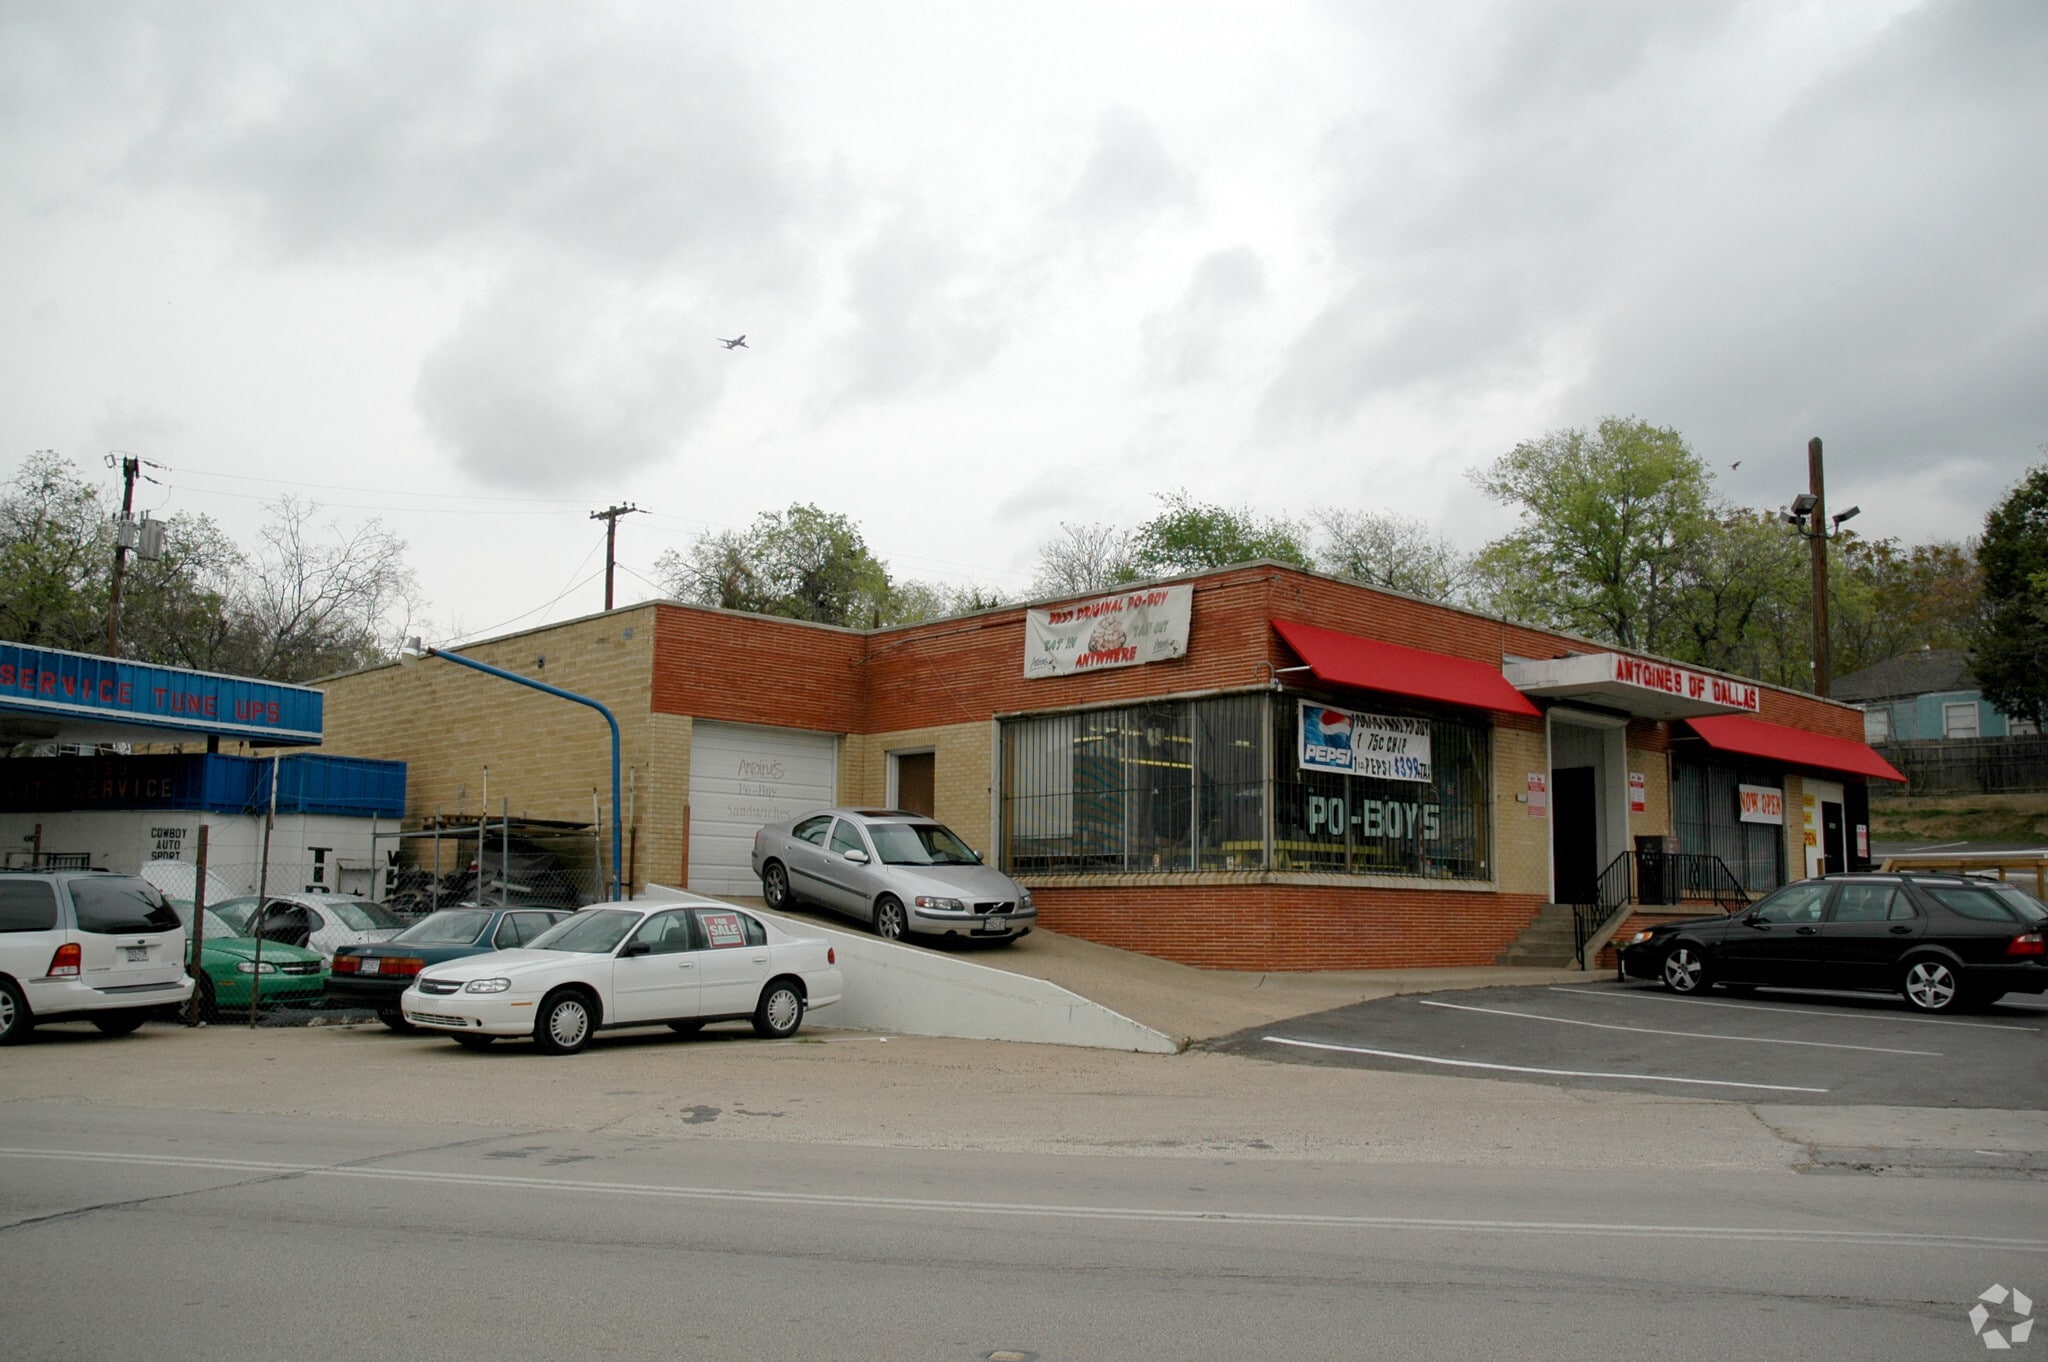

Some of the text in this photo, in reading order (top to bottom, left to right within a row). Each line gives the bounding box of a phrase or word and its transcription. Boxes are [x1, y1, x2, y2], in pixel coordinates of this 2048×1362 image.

[1076, 597, 1123, 620] ORIGINAL
[1127, 591, 1168, 611] PO-BOY
[1065, 637, 1077, 650] IN
[1075, 646, 1137, 669] ANYWHERE
[0, 664, 280, 723] SERVICE TUNE UPS
[1616, 658, 1756, 710] ANTOINES OF DALLAS
[1305, 744, 1352, 766] PEPSI
[1386, 736, 1407, 754] CHIP
[1365, 757, 1391, 777] PEPSI
[1740, 791, 1759, 815] NOW
[1761, 793, 1782, 816] OPEN
[1309, 795, 1441, 841] PO-BOYS
[151, 827, 187, 838] COWBOY
[156, 840, 181, 850] AUTO
[151, 851, 181, 861] SPORT
[710, 924, 739, 936] SALE
[714, 917, 728, 925] FOR
